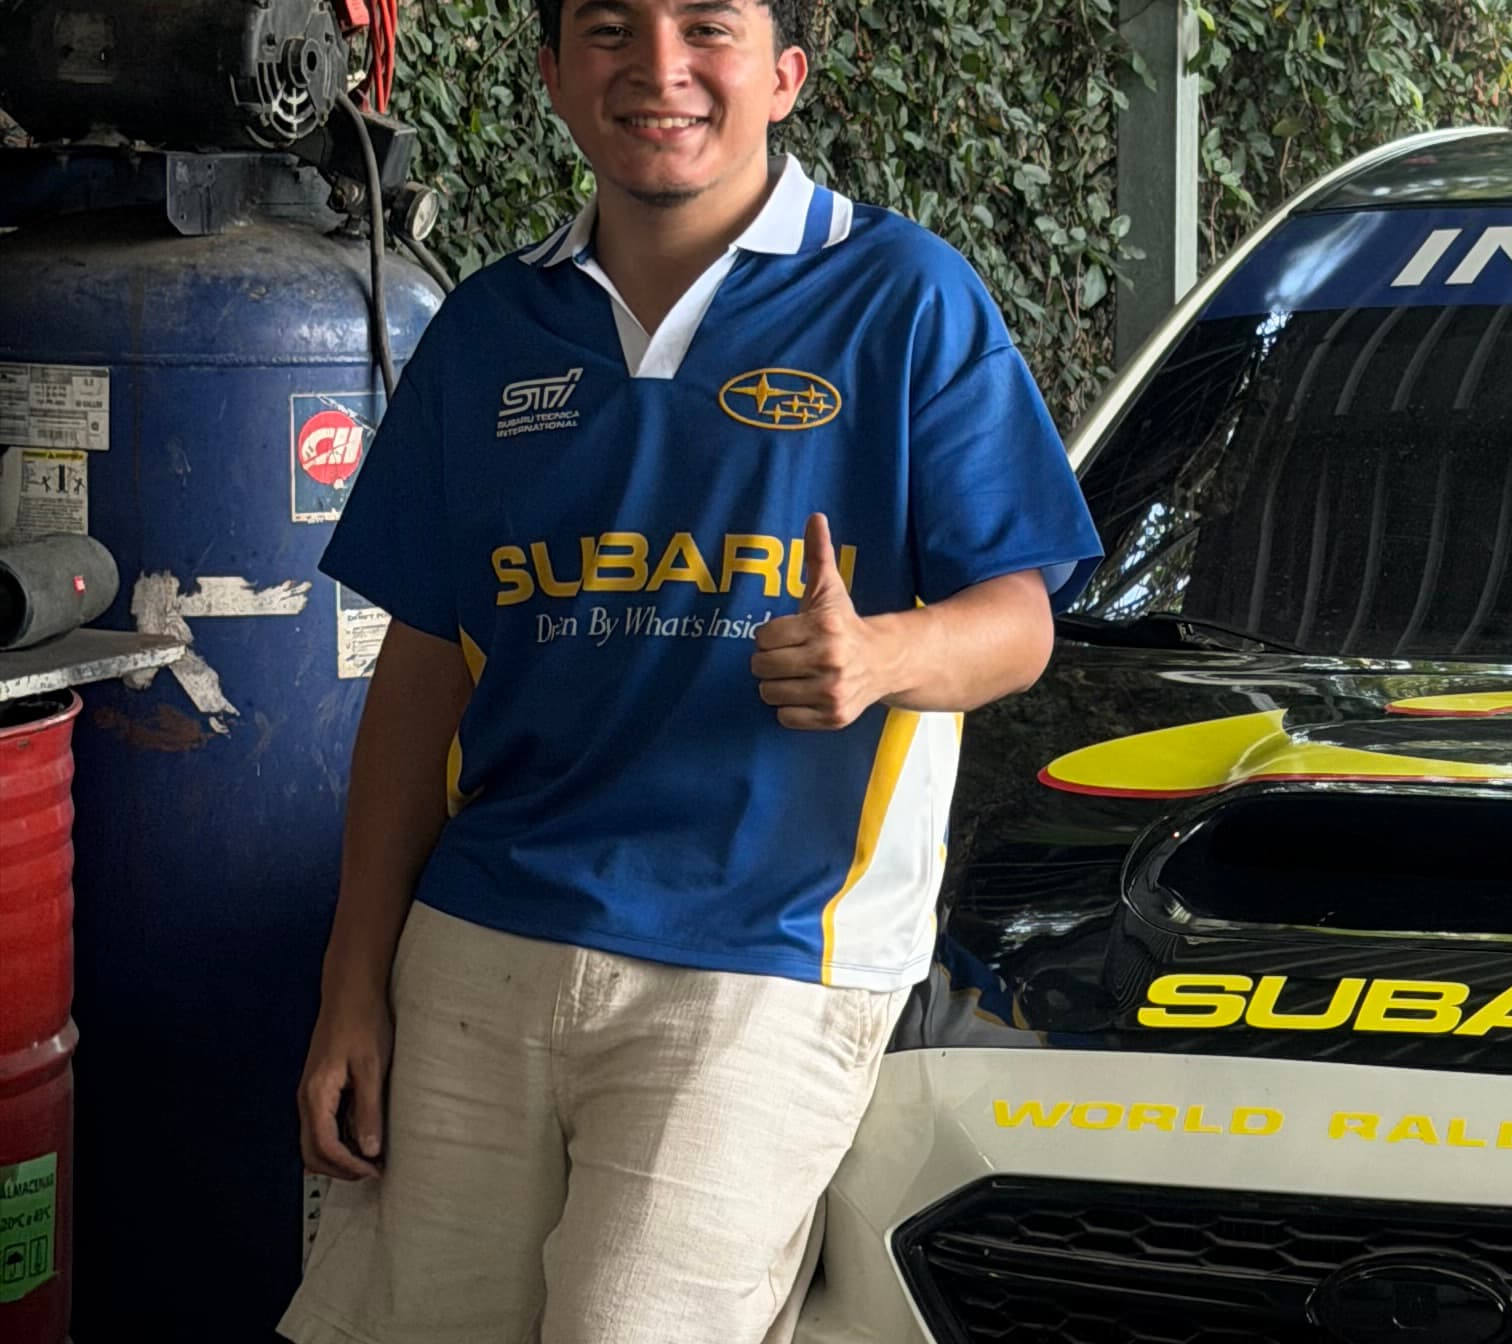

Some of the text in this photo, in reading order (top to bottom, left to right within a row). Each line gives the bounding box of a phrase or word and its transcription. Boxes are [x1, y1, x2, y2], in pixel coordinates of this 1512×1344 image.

[496, 419, 579, 438] INTERNATIONAL
[588, 606, 618, 647] By
[623, 606, 704, 637] What's
[707, 607, 772, 639] Insid
[992, 1099, 1285, 1137] WORLD
